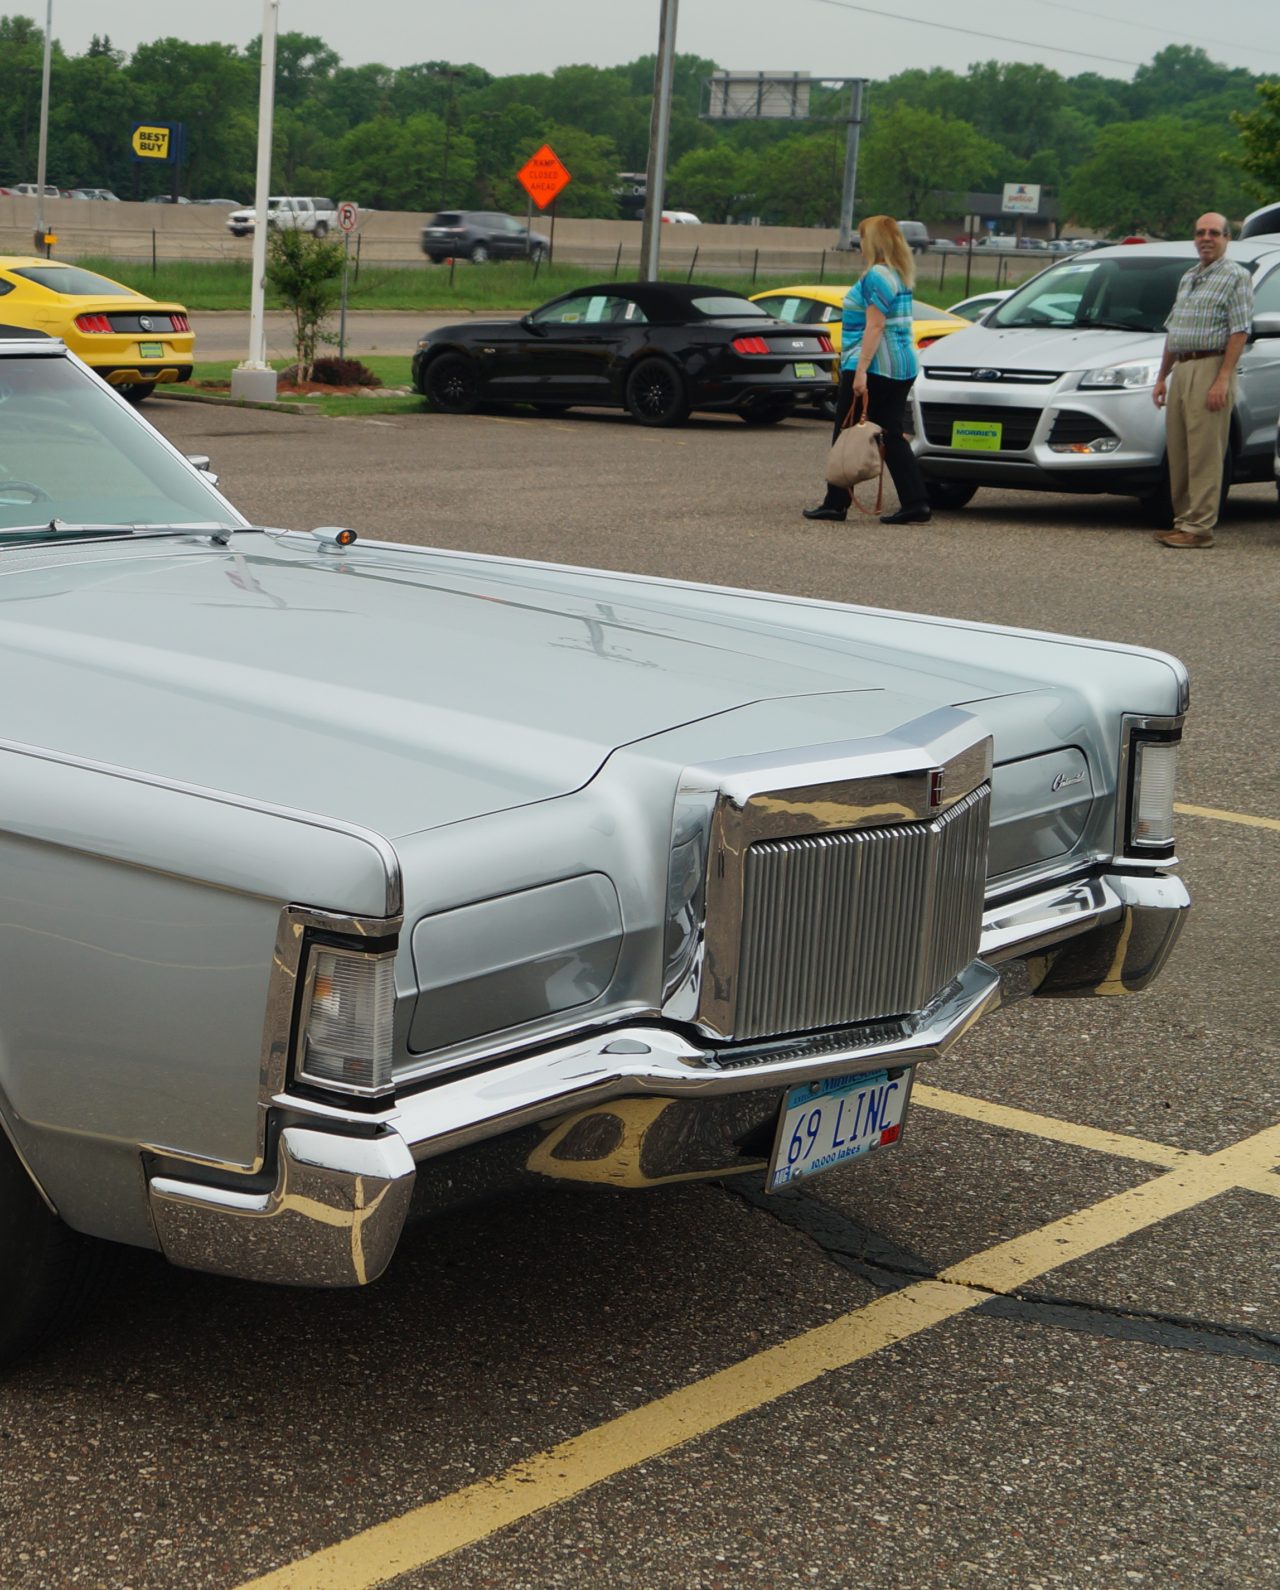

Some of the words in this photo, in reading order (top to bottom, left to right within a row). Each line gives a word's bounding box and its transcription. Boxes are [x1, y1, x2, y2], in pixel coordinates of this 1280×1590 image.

[140, 132, 167, 142] BEST
[140, 143, 163, 152] BUY
[529, 171, 558, 179] CLOSED
[530, 182, 555, 191] AHEAD
[787, 1108, 822, 1165] 69
[832, 1083, 899, 1149] LINC
[811, 1153, 836, 1170] 10,000
[837, 1144, 861, 1160] lakes
